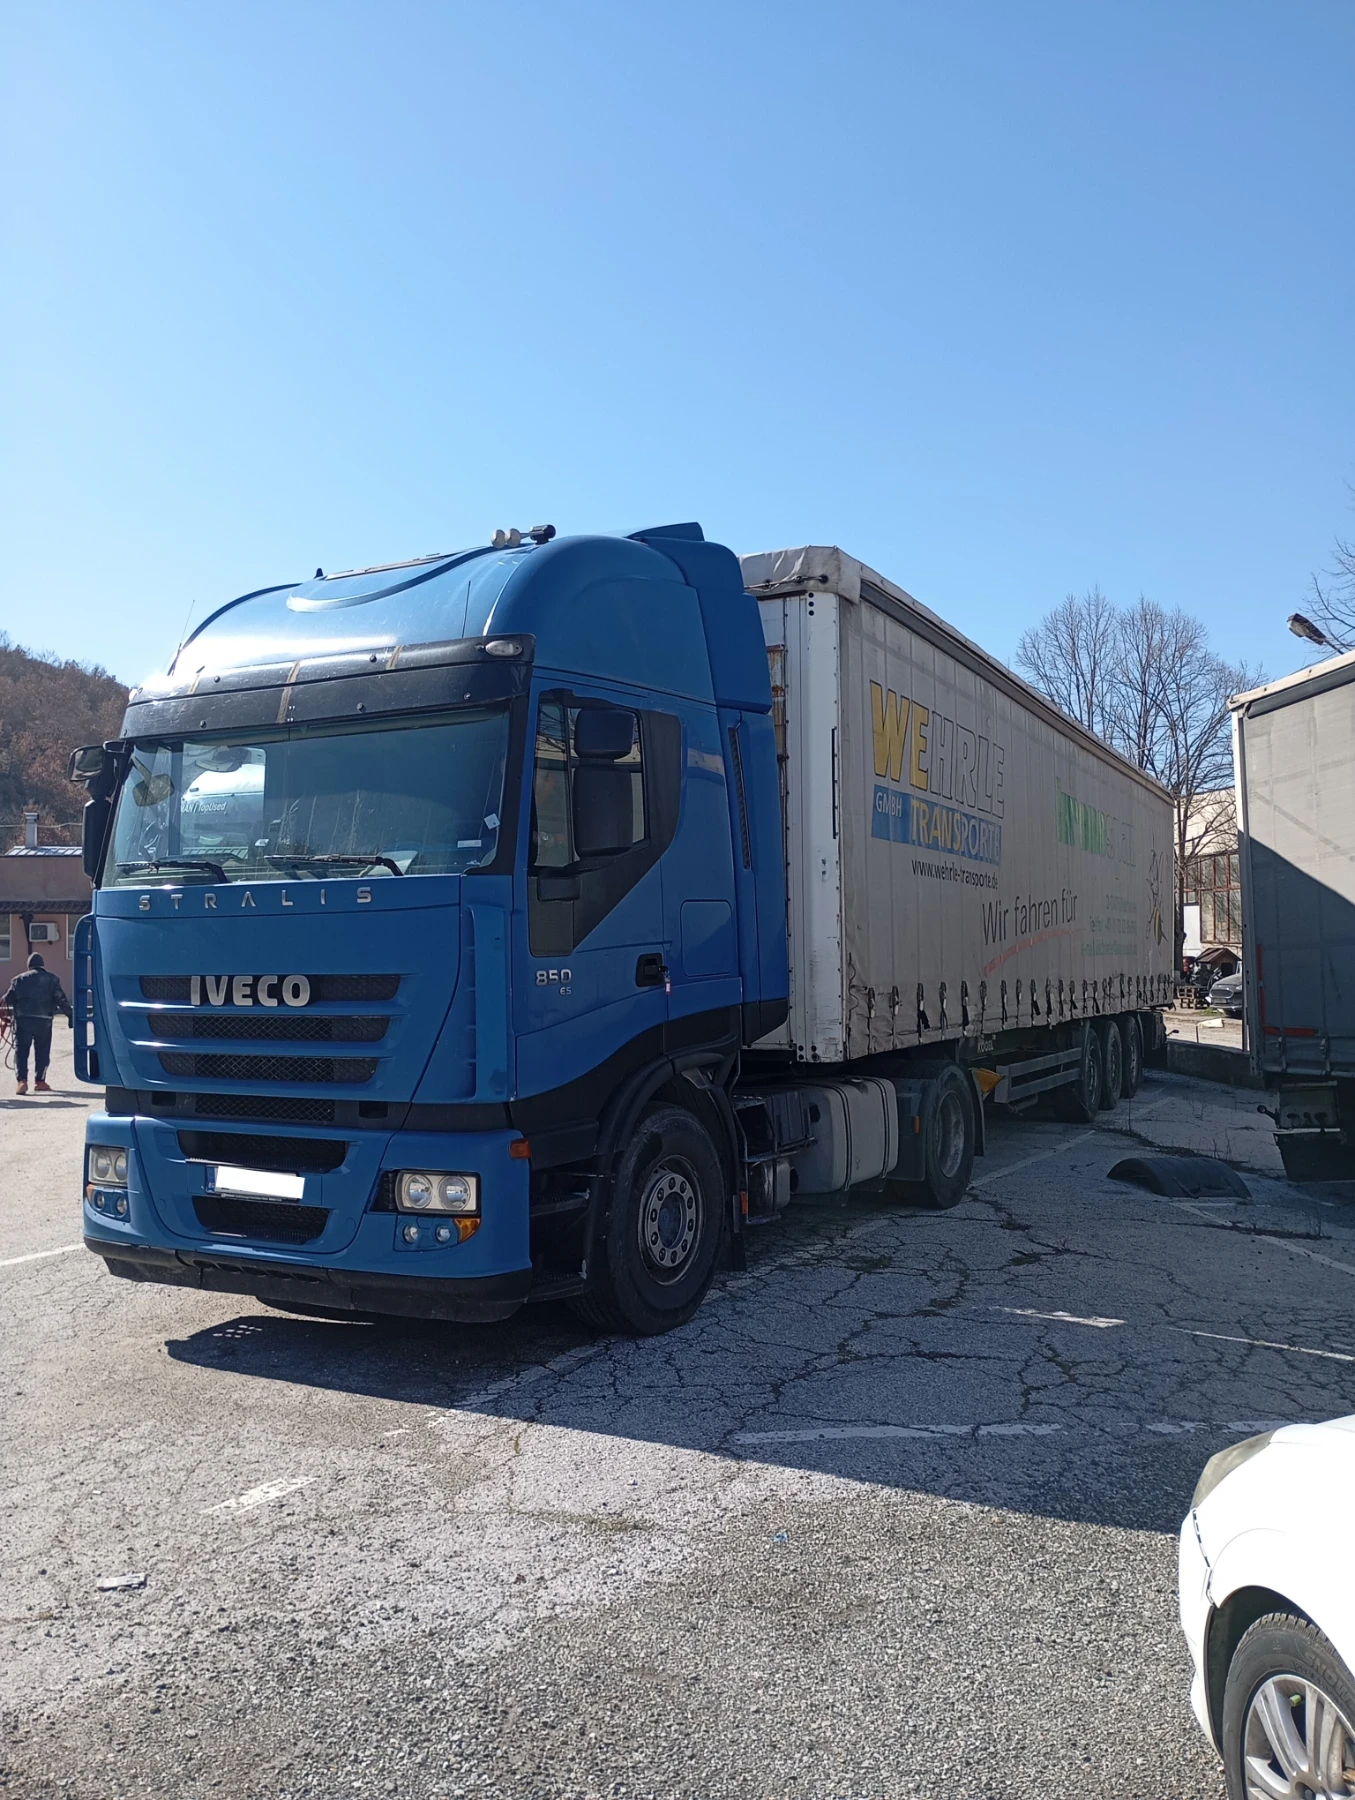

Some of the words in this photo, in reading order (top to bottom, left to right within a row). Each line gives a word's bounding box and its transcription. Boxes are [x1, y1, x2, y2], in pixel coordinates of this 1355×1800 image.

[870, 679, 1004, 819] WEHRLE
[876, 792, 902, 817] GMBH
[139, 886, 372, 911] STRALIS
[982, 900, 1009, 945] Wir
[1014, 896, 1058, 936] fahren
[1061, 888, 1078, 923] für
[190, 974, 310, 1007] IVECO
[536, 968, 572, 986] 850
